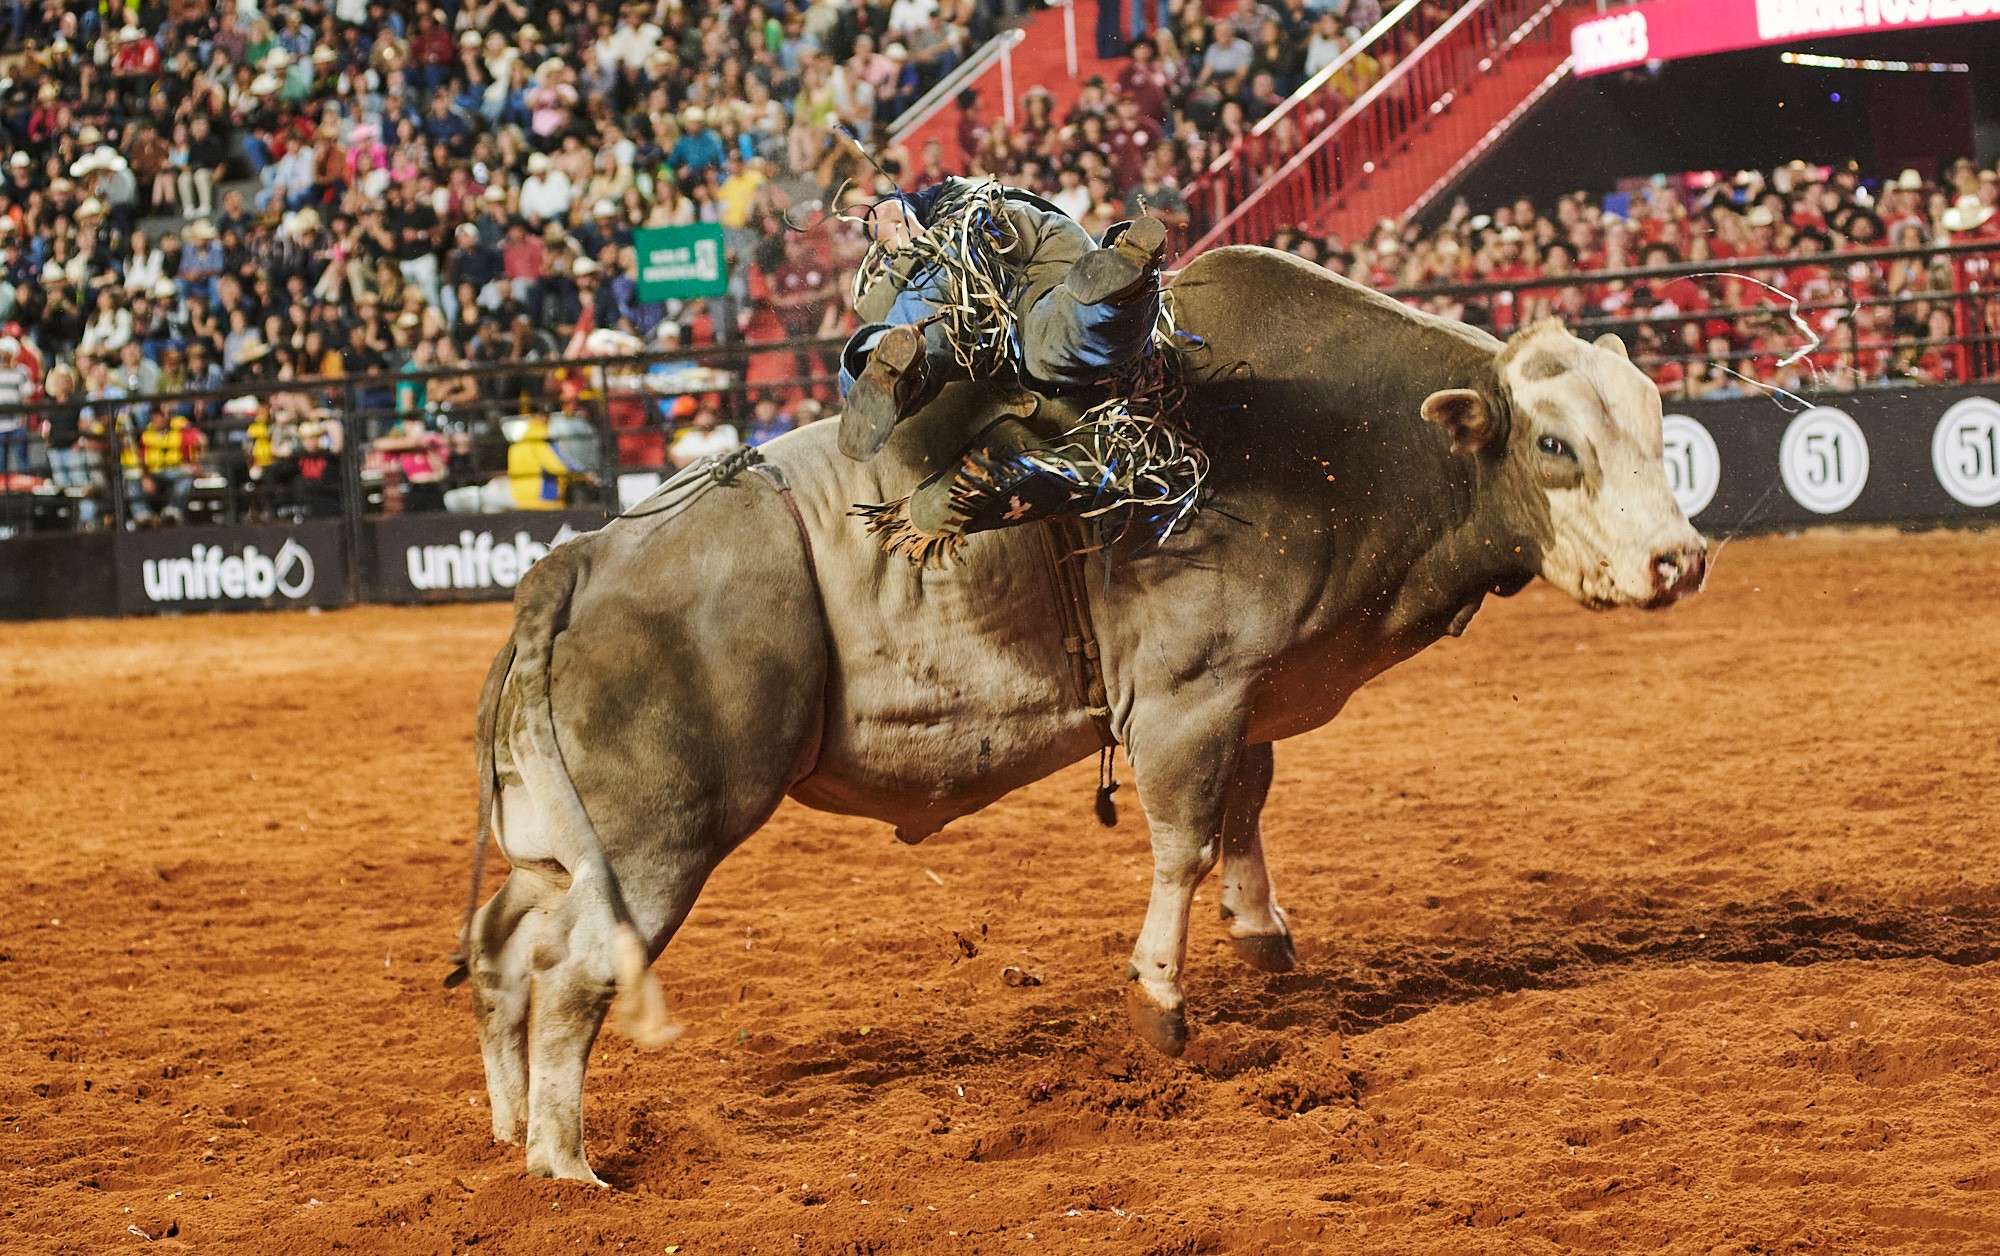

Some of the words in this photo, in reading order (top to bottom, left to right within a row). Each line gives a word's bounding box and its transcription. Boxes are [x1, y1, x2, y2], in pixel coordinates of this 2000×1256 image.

[1807, 434, 1842, 486] 51
[1959, 426, 1997, 479] 51
[142, 543, 277, 600] unifeb
[407, 529, 548, 589] unifeb
